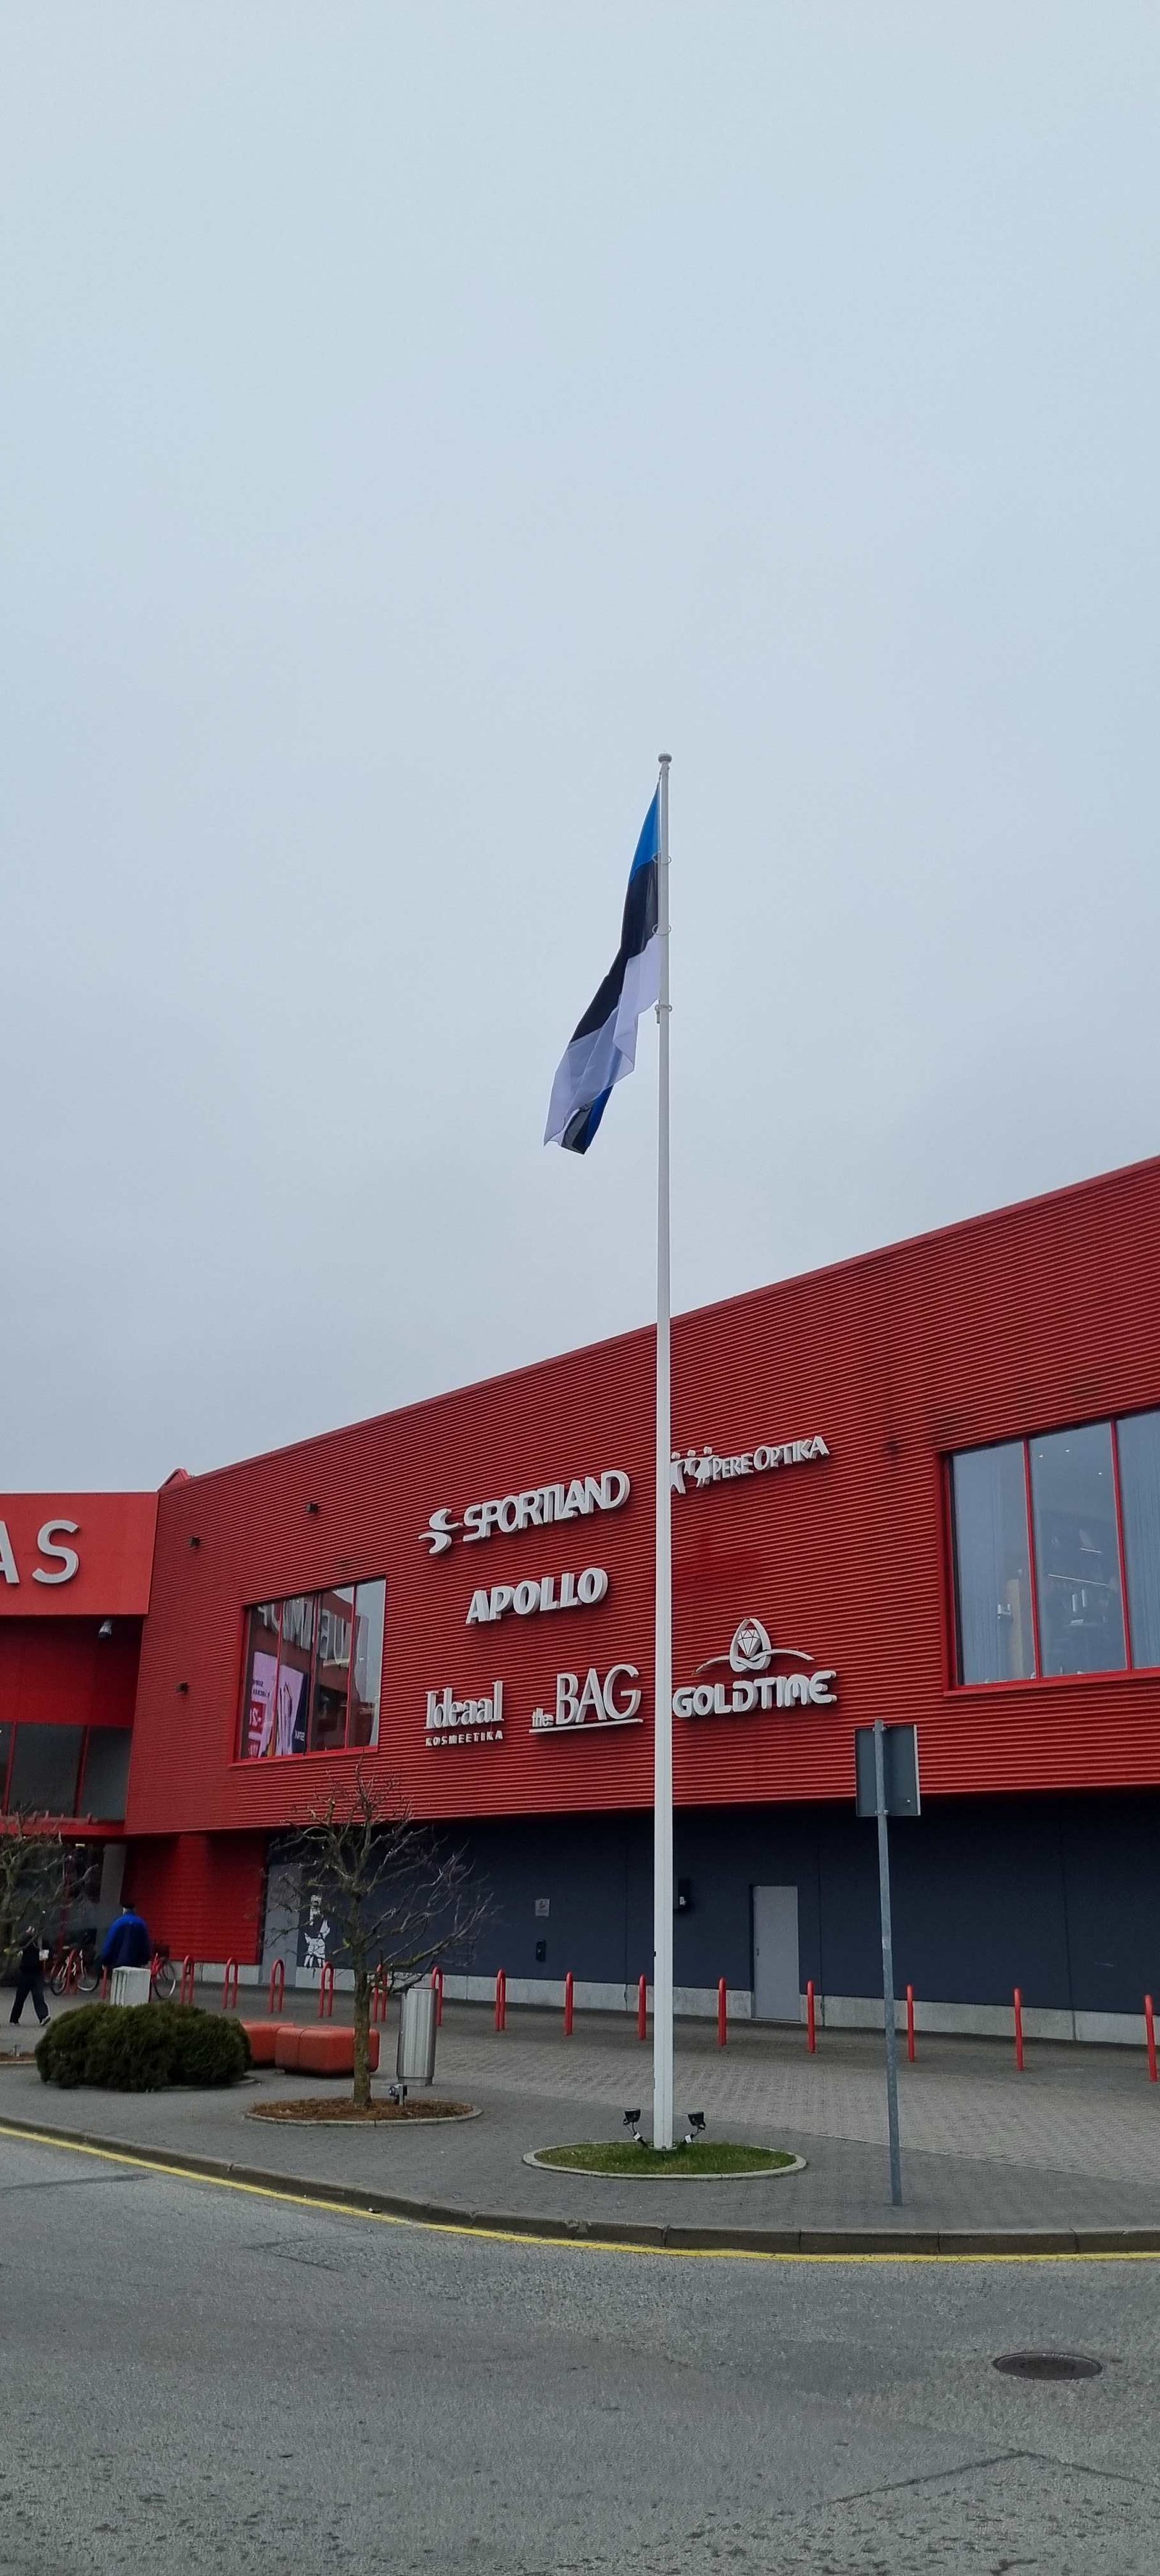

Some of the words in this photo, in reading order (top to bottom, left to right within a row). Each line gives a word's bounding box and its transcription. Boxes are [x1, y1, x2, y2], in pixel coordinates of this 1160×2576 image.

[711, 1453, 754, 1481] PERE
[753, 1435, 830, 1471] OPTIKA
[463, 1469, 631, 1542] SPORTLAND
[465, 1567, 608, 1624] APOLLO
[423, 1680, 505, 1730] Ideaal
[555, 1664, 642, 1725] BAG
[672, 1670, 837, 1717] GOLDTIME
[426, 1730, 503, 1746] KOSMEETIKA
